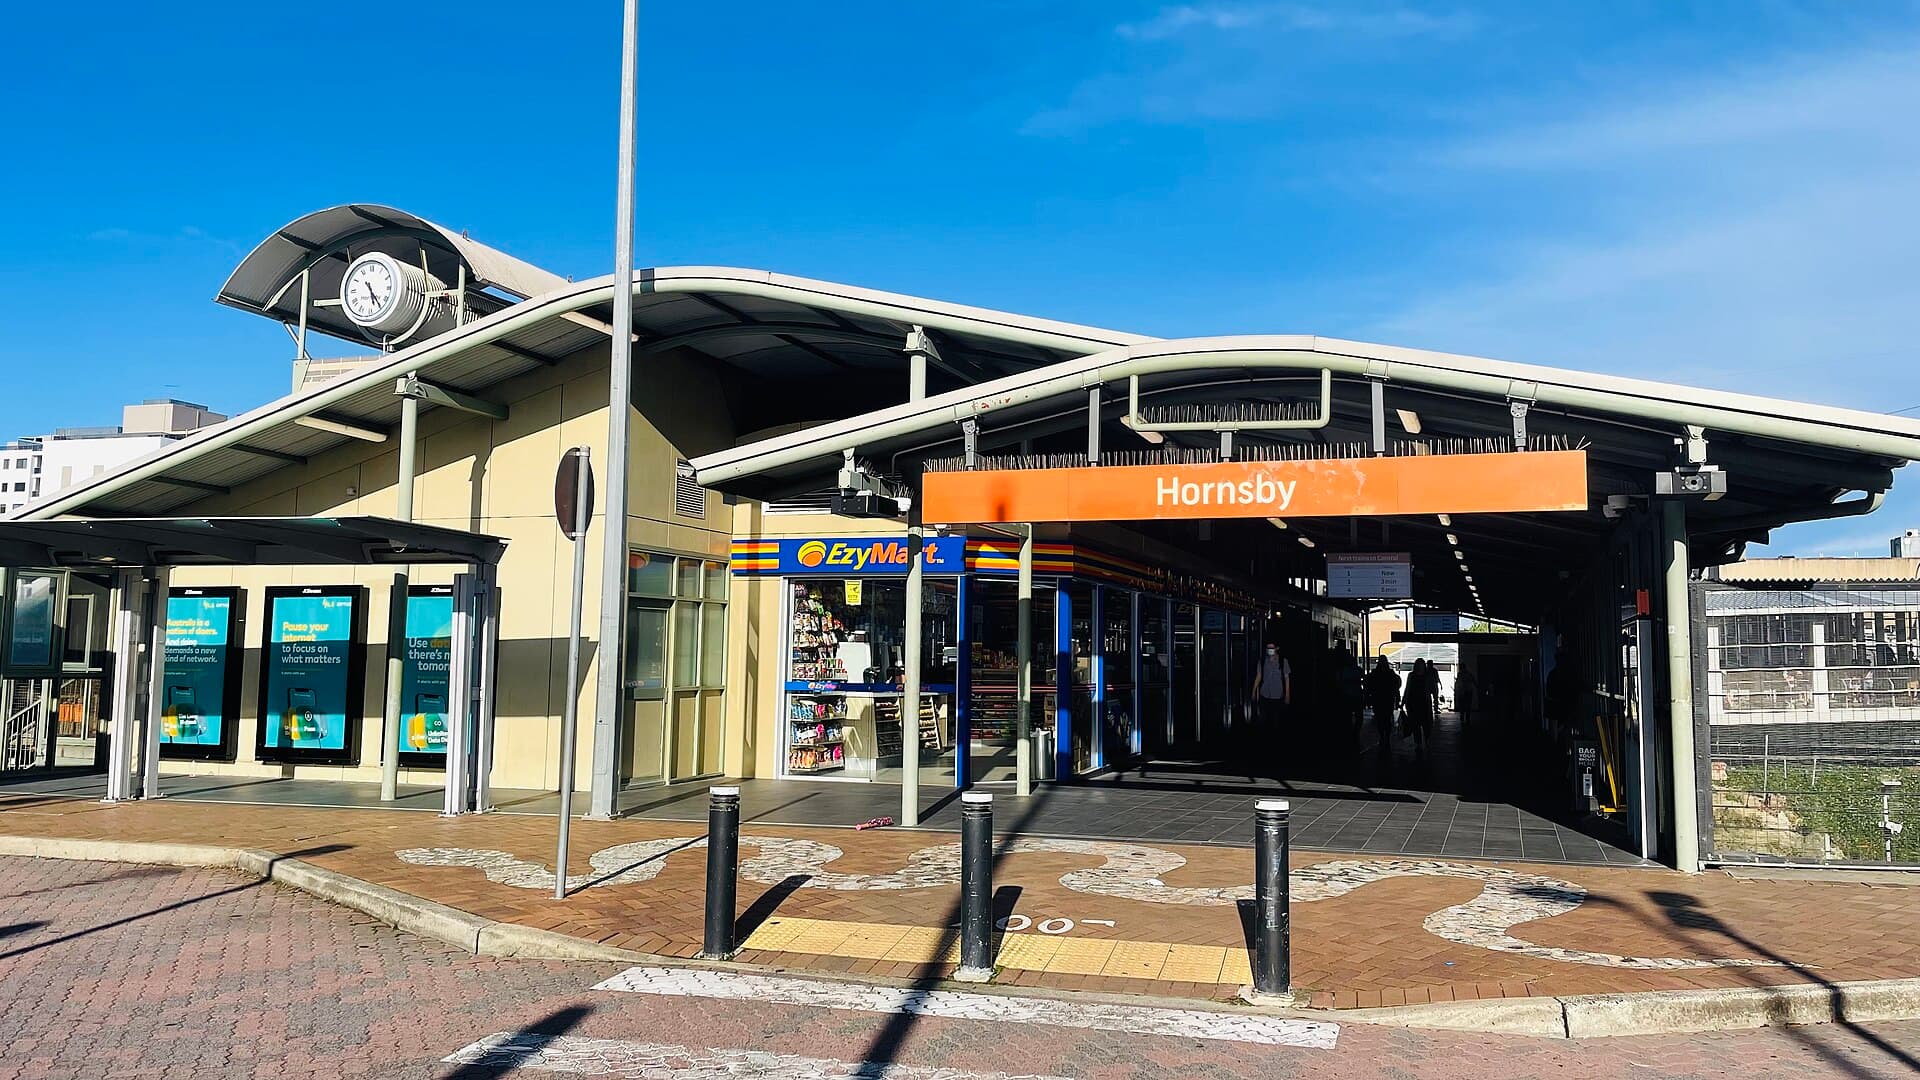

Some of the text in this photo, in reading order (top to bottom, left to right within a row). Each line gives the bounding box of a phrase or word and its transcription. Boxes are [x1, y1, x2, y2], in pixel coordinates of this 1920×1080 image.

[1157, 474, 1297, 511] Hornsby
[826, 543, 939, 570] EzyMat
[282, 622, 329, 634] Pause your
[282, 645, 291, 653] to
[293, 643, 316, 653] focus
[409, 638, 428, 648] Use
[282, 655, 341, 664] what matters
[408, 649, 442, 660] there's
